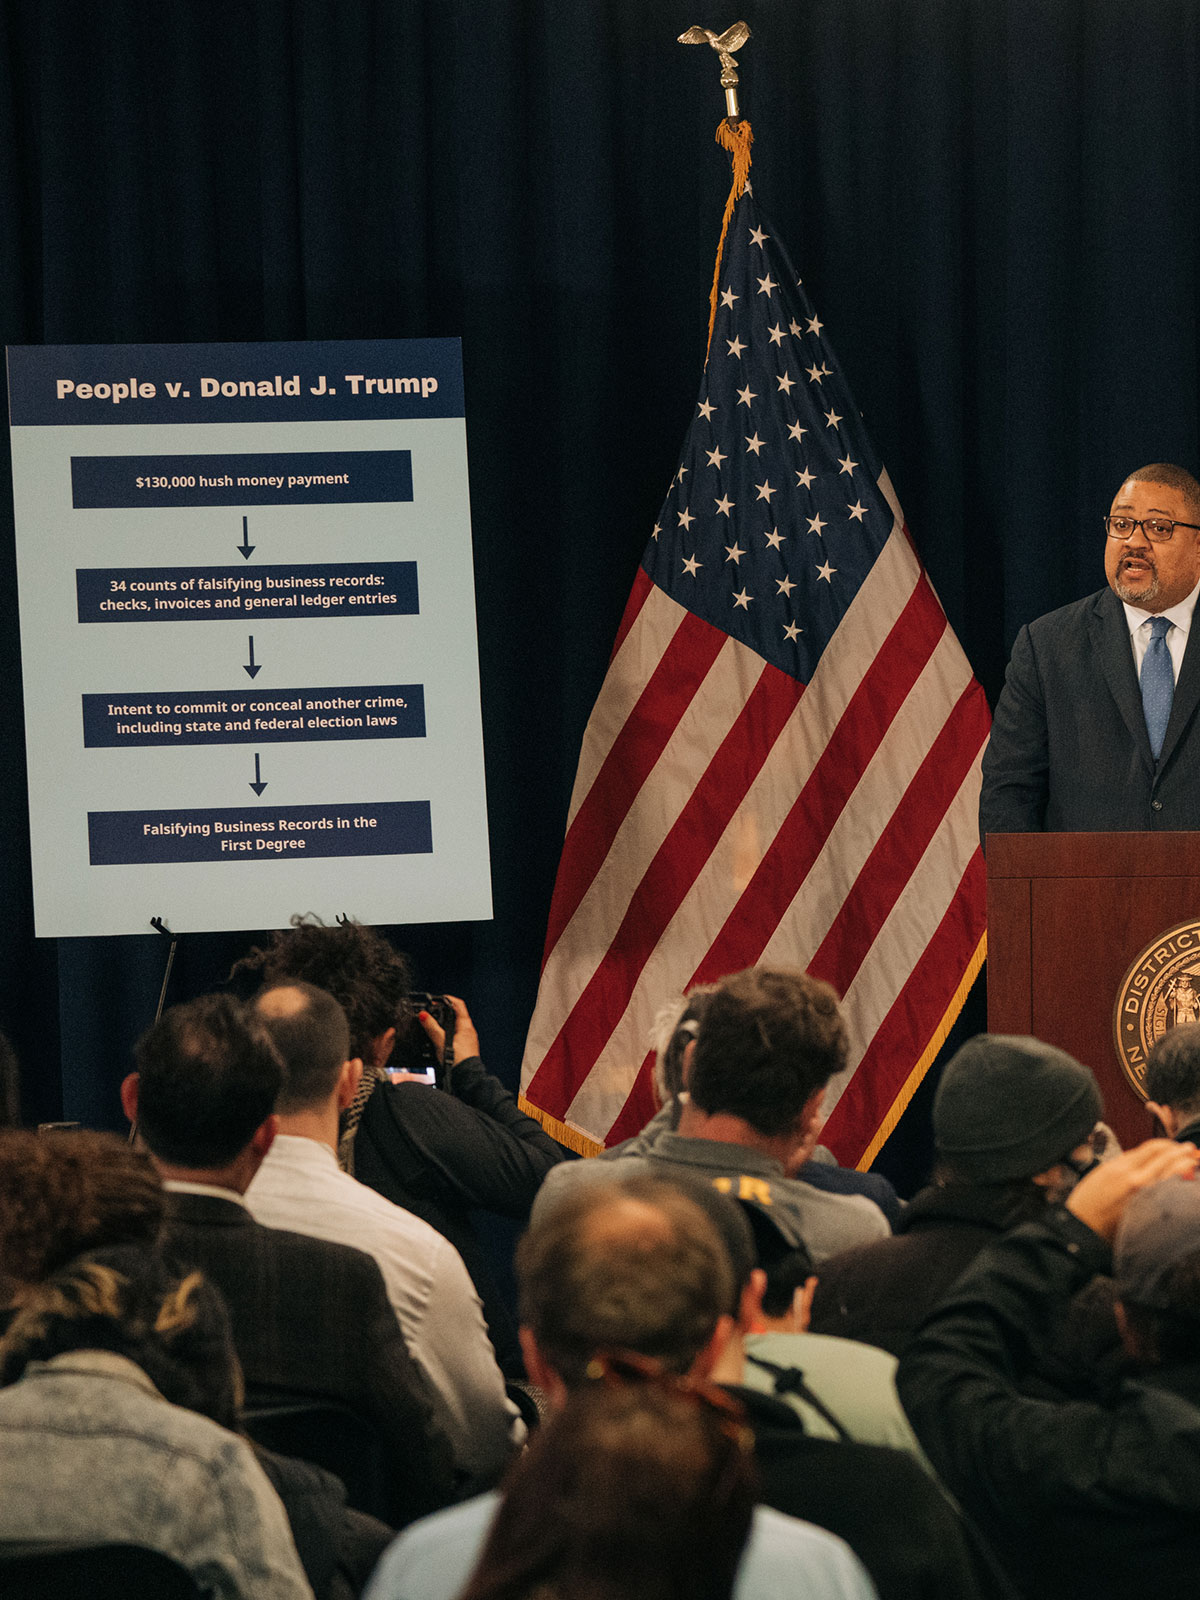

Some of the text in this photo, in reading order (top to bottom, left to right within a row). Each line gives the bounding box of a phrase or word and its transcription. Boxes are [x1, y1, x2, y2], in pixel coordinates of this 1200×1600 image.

[56, 375, 438, 404] People v. Donald J. Trump
[135, 473, 350, 489] $130,000 hush money payment
[110, 574, 385, 593] 34 counts of falsifying business records:
[99, 592, 397, 611] checks, invoices and general ledger entries
[107, 696, 408, 716] Intent to commit or conceal another crime,
[117, 714, 398, 736] including state and federal election laws
[143, 816, 377, 838] Falsifying Business Records in the
[221, 839, 306, 853] First Degree
[1126, 1045, 1146, 1081] NE
